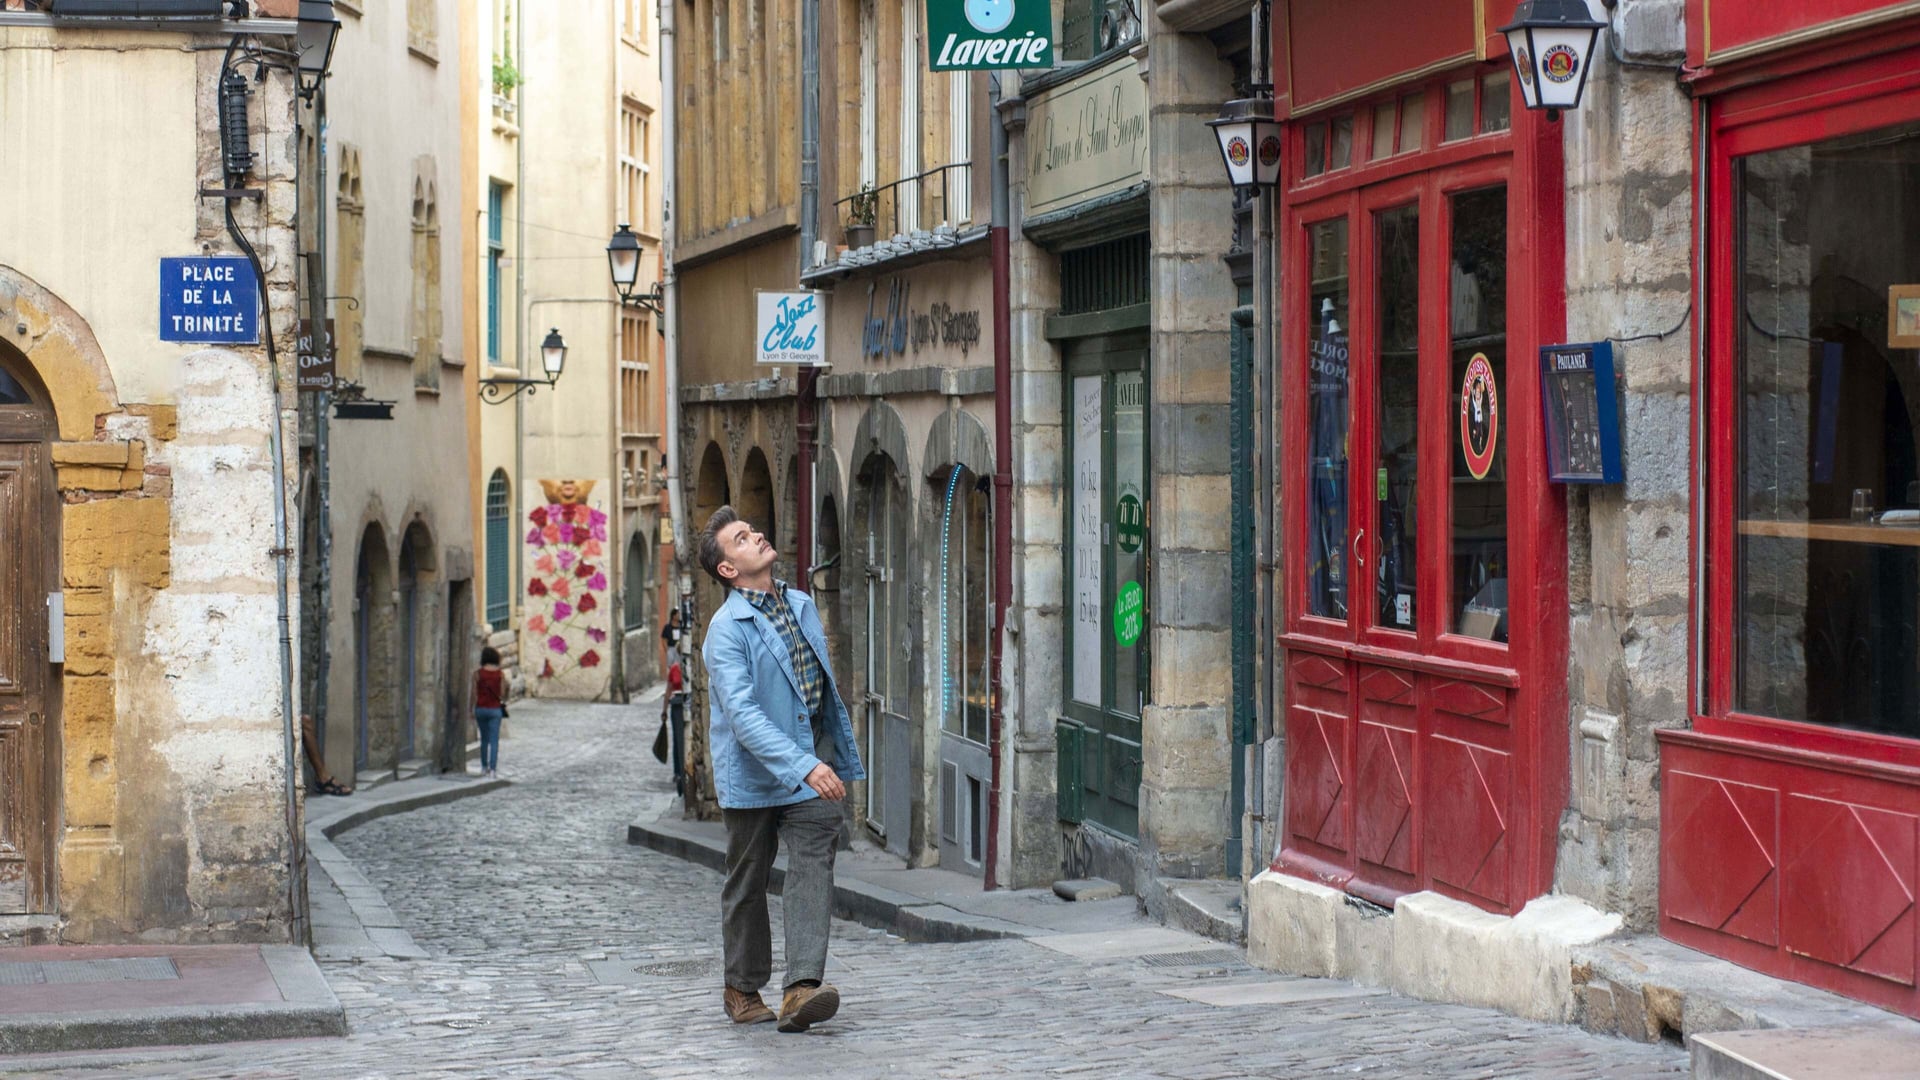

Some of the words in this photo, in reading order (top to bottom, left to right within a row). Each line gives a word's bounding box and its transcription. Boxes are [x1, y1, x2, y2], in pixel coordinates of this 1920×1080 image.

[936, 30, 1048, 66] Laverie
[182, 266, 235, 282] PLACE
[183, 289, 203, 304] DE
[212, 289, 233, 304] LA
[172, 312, 244, 332] TRINITÉ
[776, 295, 816, 336] Jazz
[763, 322, 818, 352] Club
[763, 352, 780, 360] Lyon
[789, 352, 819, 361] Georges
[1557, 353, 1587, 370] PAULANER
[1081, 461, 1087, 491] 6
[1088, 459, 1097, 499] kg
[1081, 505, 1087, 535] 8
[1088, 503, 1097, 543] kg
[1089, 548, 1099, 588] kg
[1088, 591, 1098, 633] kg
